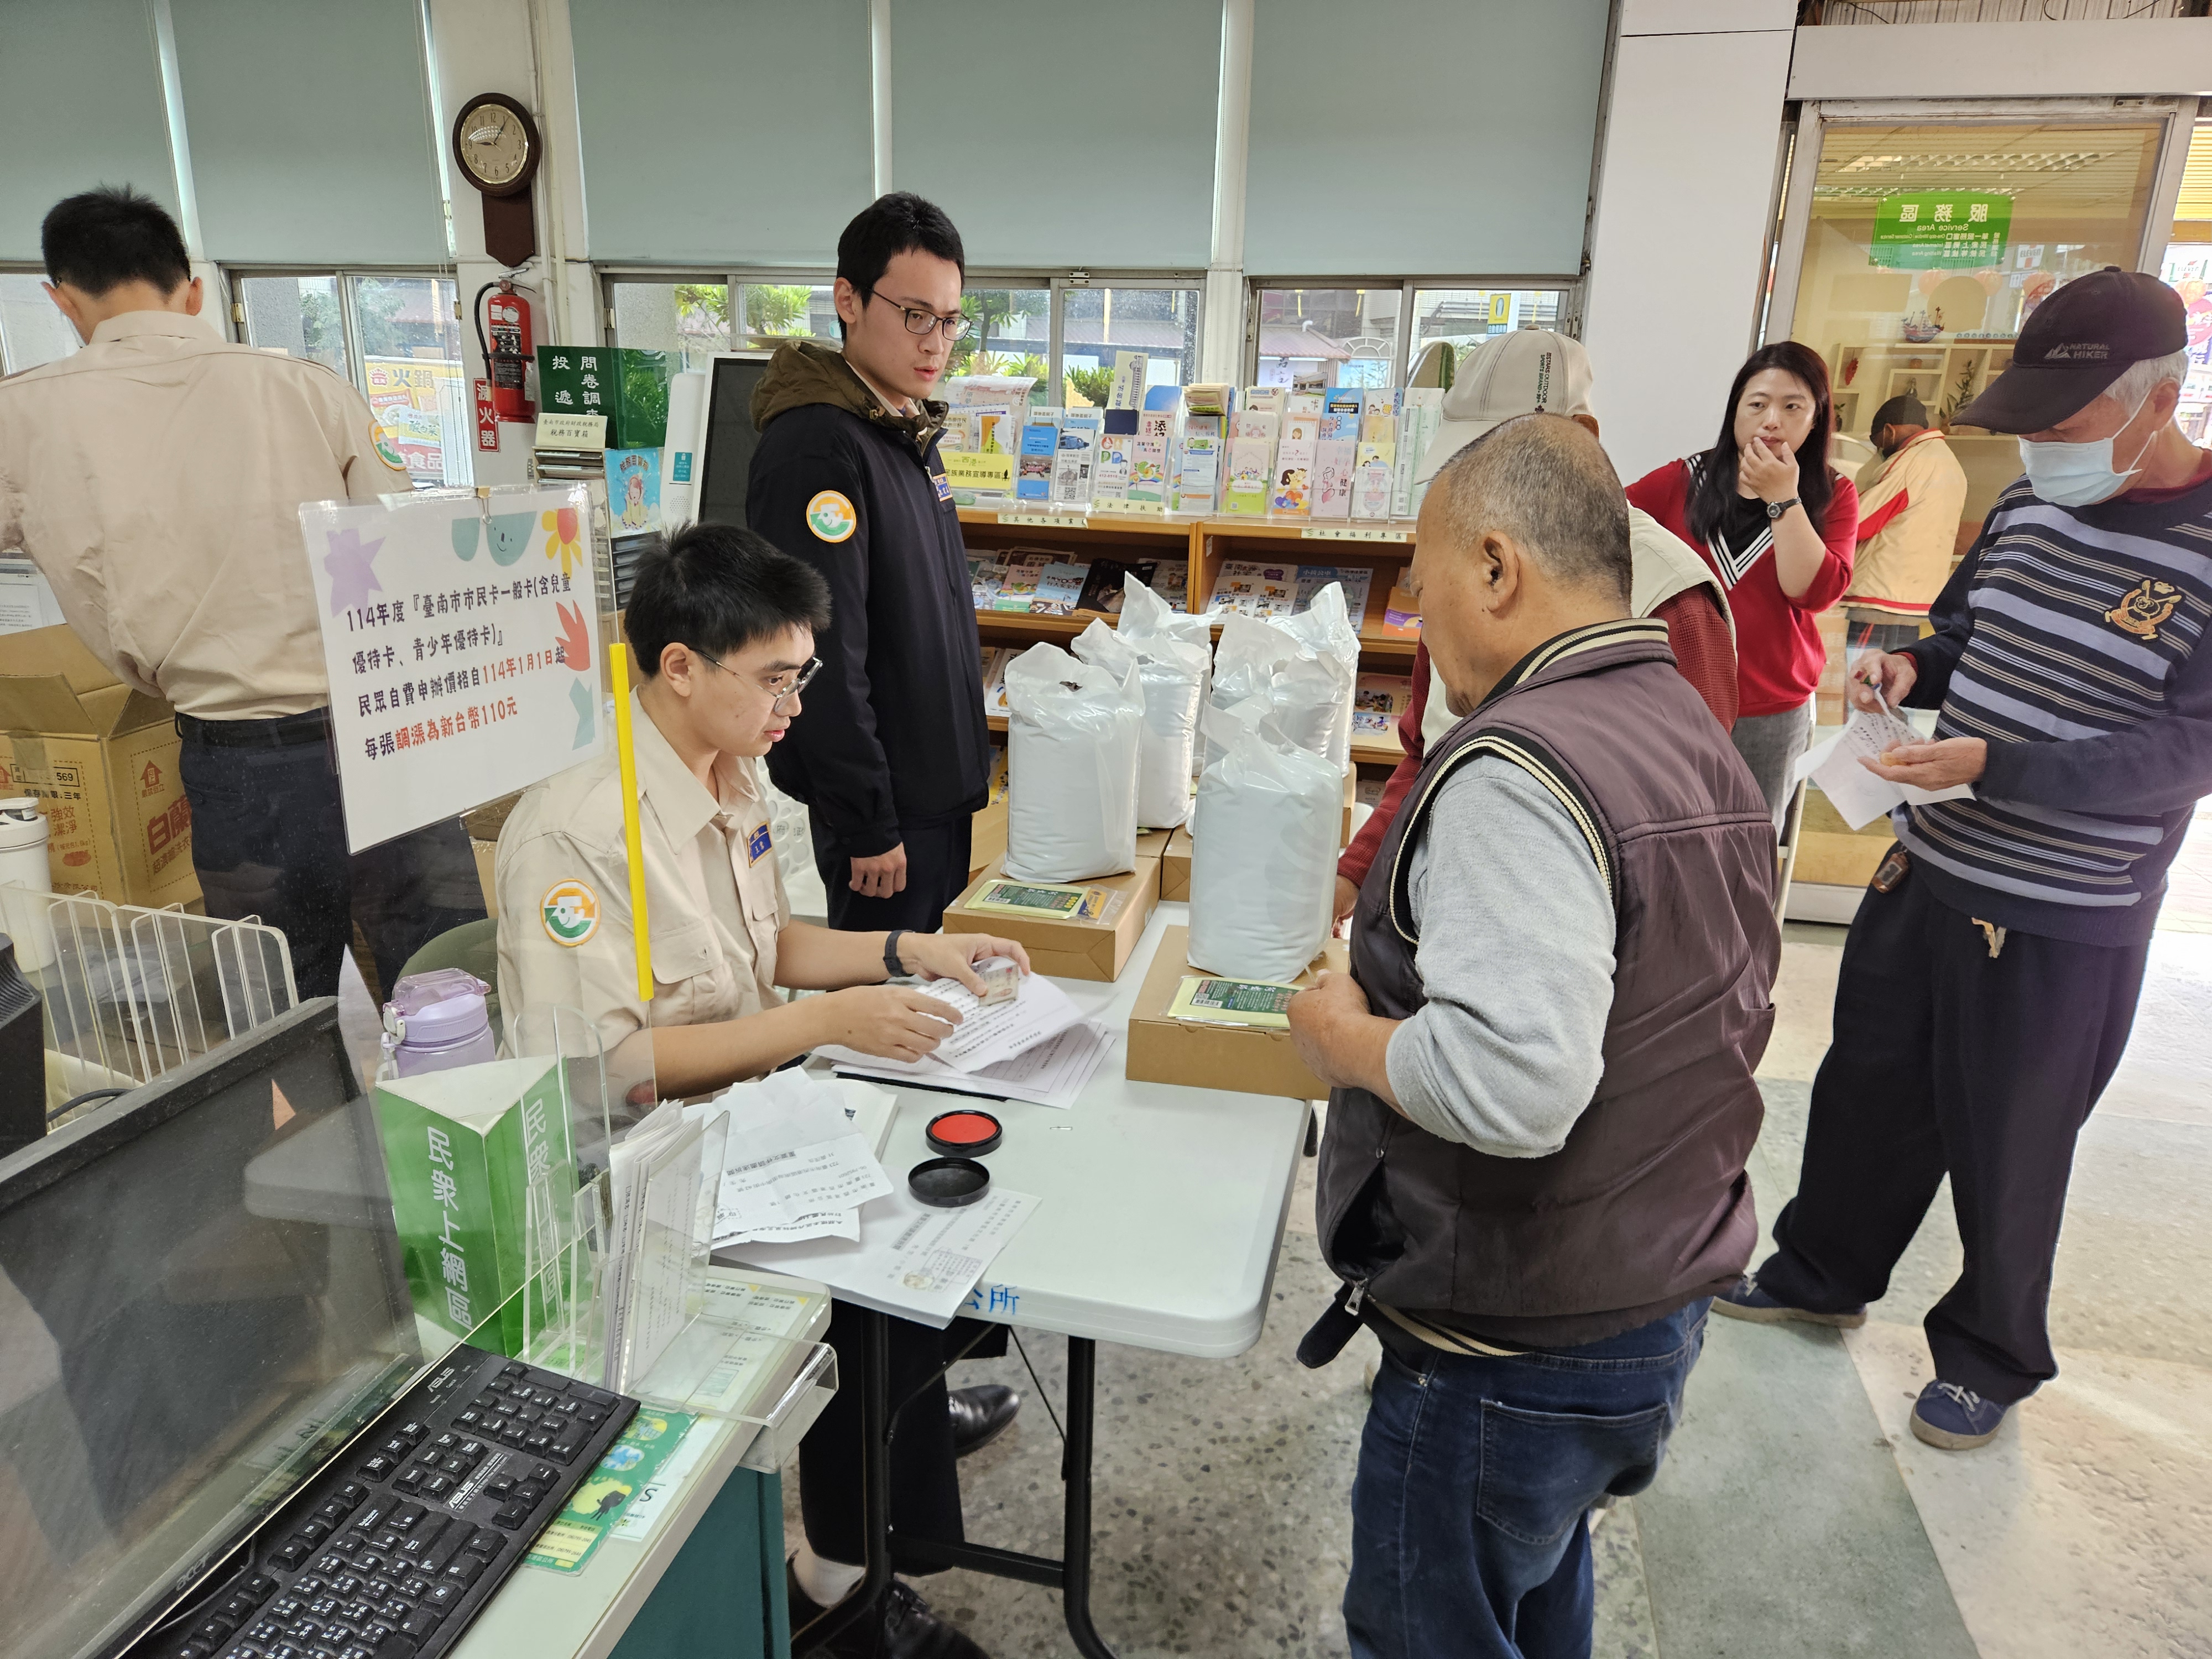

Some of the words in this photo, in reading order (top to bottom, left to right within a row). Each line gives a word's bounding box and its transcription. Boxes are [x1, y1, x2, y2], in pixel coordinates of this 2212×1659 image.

[480, 116, 485, 126] 11
[491, 112, 496, 123] 12
[512, 124, 517, 135] 2
[517, 139, 521, 150] 3
[474, 154, 478, 164] 8
[494, 166, 499, 176] 6
[505, 163, 510, 174] 5
[2070, 343, 2110, 352] NATURAL
[2073, 351, 2108, 359] HIKER
[392, 369, 434, 388] 火鍋
[552, 356, 573, 405] 投遞
[1541, 374, 1550, 404] OUTDOOR
[408, 421, 439, 436] 酸白菜
[543, 419, 599, 428] 臺南市政府財政稅務局
[550, 429, 588, 438] 稅務百寶箱
[962, 456, 978, 467] 西港
[945, 469, 1001, 479] 民族業務宣導專區
[1107, 502, 1163, 513] 法律扶助
[1319, 529, 1402, 541] 社會福利專區
[347, 572, 571, 632] 114年度『臺南市市民卡一般卡(含兒童
[352, 623, 503, 674] 優待卡、青少年優待卡)』
[358, 646, 566, 717] 民眾自費申辦價格自114年1月1日起
[364, 696, 518, 761] 每張調漲為新台幣110元
[56, 772, 74, 782] 569
[152, 834, 193, 875] 超濃縮洗衣
[427, 1126, 473, 1331] 民眾上網區
[427, 1367, 455, 1392] ASUS
[405, 1470, 418, 1479] Insert
[430, 1478, 443, 1488] Delete
[448, 1480, 474, 1509] ASUS
[358, 1509, 378, 1526] Backspace
[176, 1552, 210, 1591] acer
